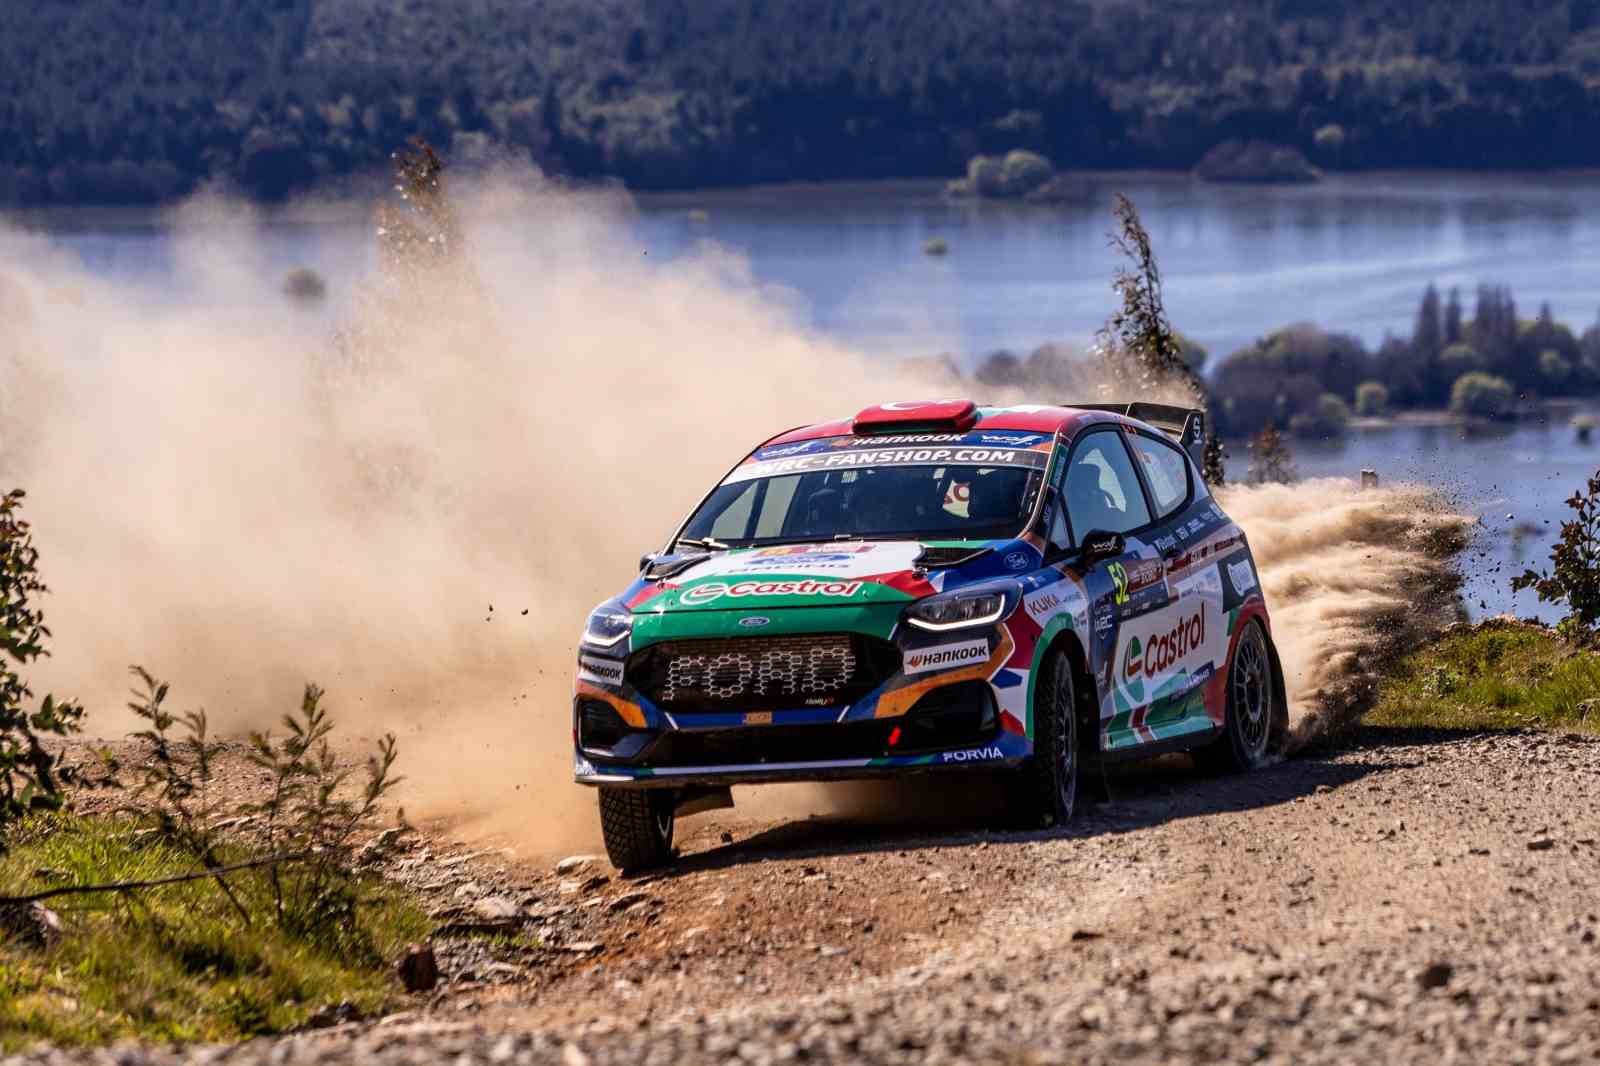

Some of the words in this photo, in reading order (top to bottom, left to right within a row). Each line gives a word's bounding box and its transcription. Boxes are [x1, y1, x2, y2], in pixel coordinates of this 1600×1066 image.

[728, 579, 862, 598] Castrol
[1107, 561, 1130, 605] 52
[1144, 600, 1205, 679] Castrol
[662, 646, 856, 701] FORD
[942, 747, 1004, 762] FORVIA
